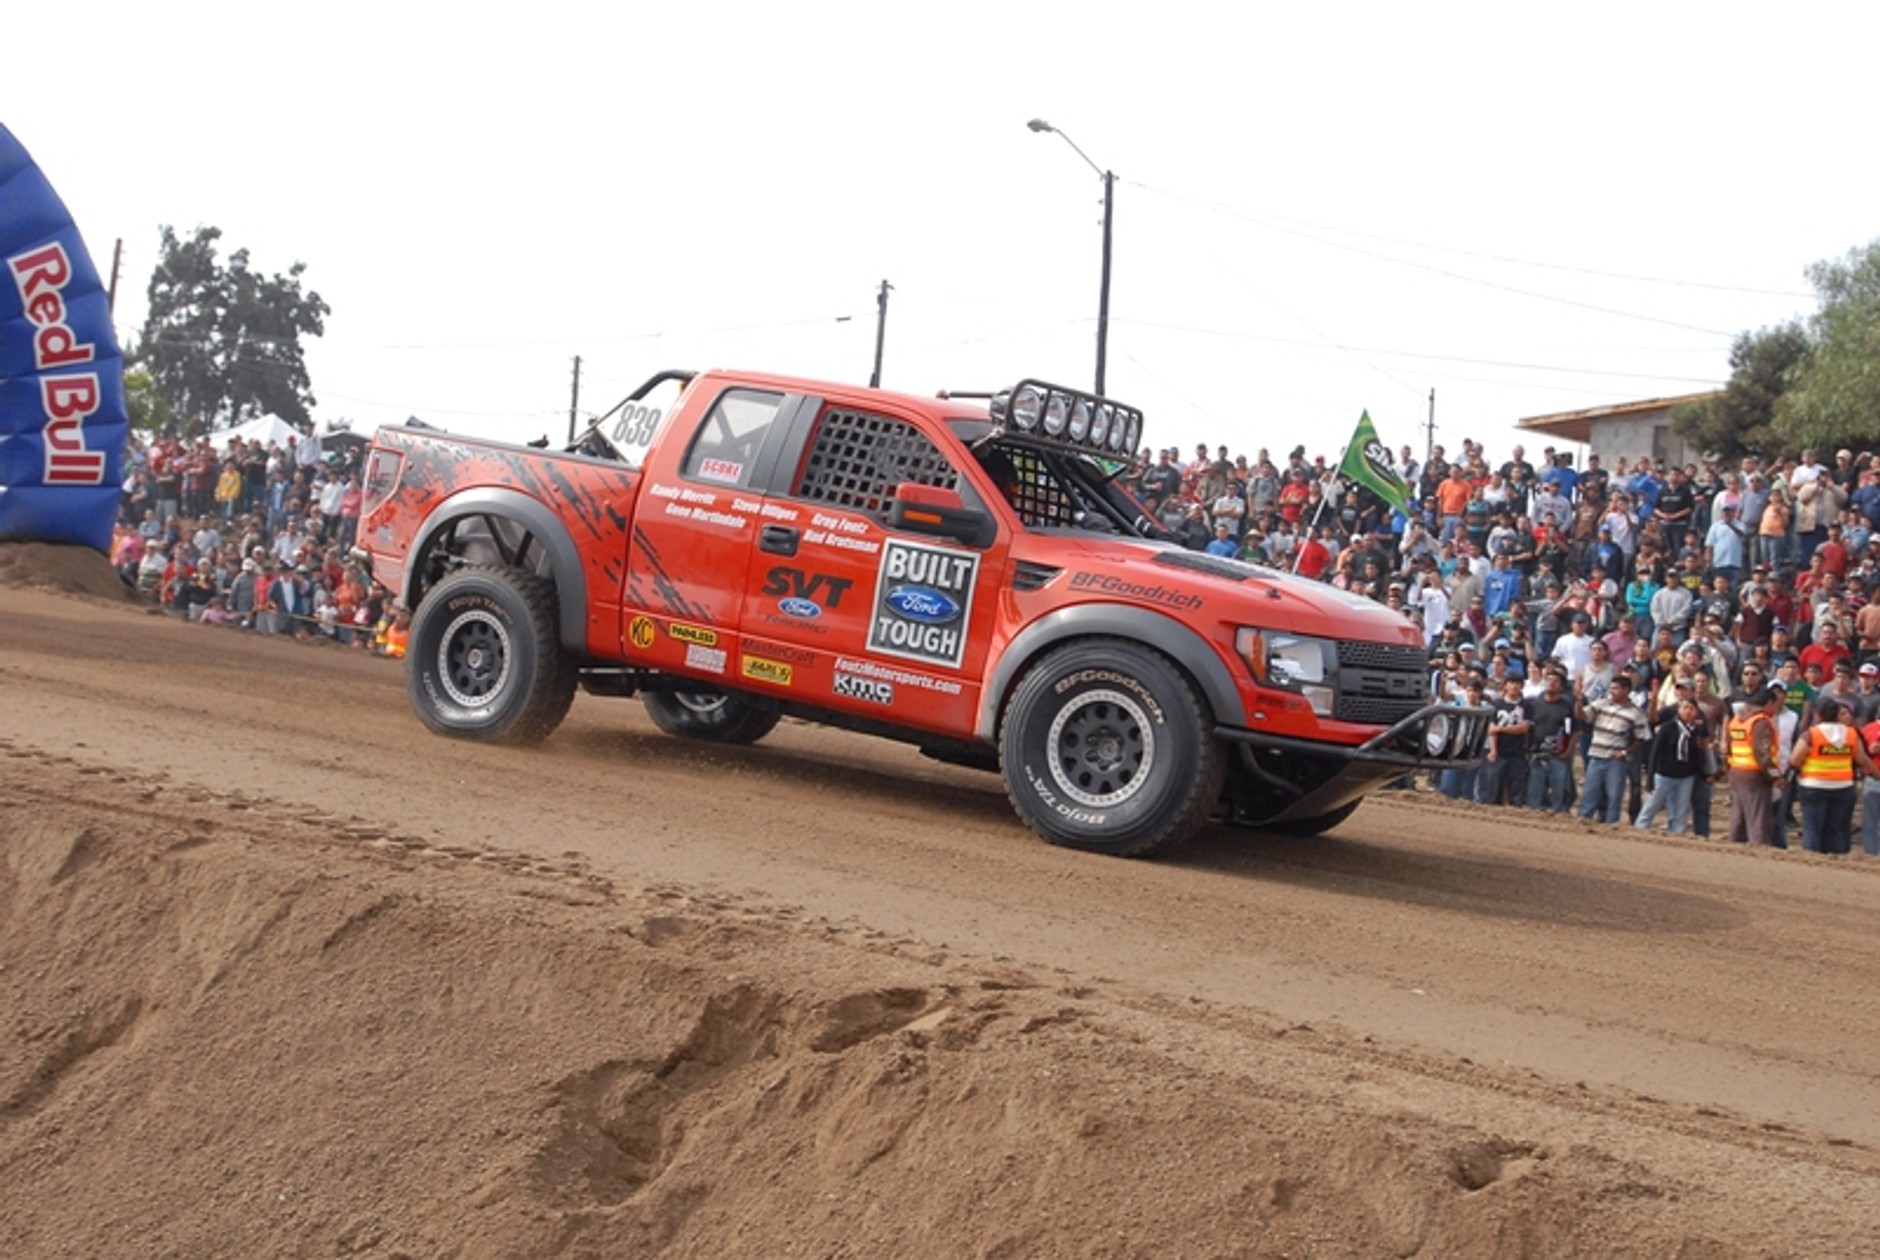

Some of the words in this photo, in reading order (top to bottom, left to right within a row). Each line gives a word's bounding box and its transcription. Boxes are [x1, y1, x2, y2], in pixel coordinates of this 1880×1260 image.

[9, 243, 94, 369] Red
[40, 372, 105, 483] Bull
[612, 404, 662, 447] 839
[761, 565, 854, 608] SVT
[887, 547, 972, 590] BUILT
[1068, 570, 1204, 610] BFGoodrich
[901, 591, 942, 615] Ford
[631, 617, 652, 646] KC
[878, 617, 958, 656] TOUGH
[1054, 669, 1164, 726] BFGoodrich
